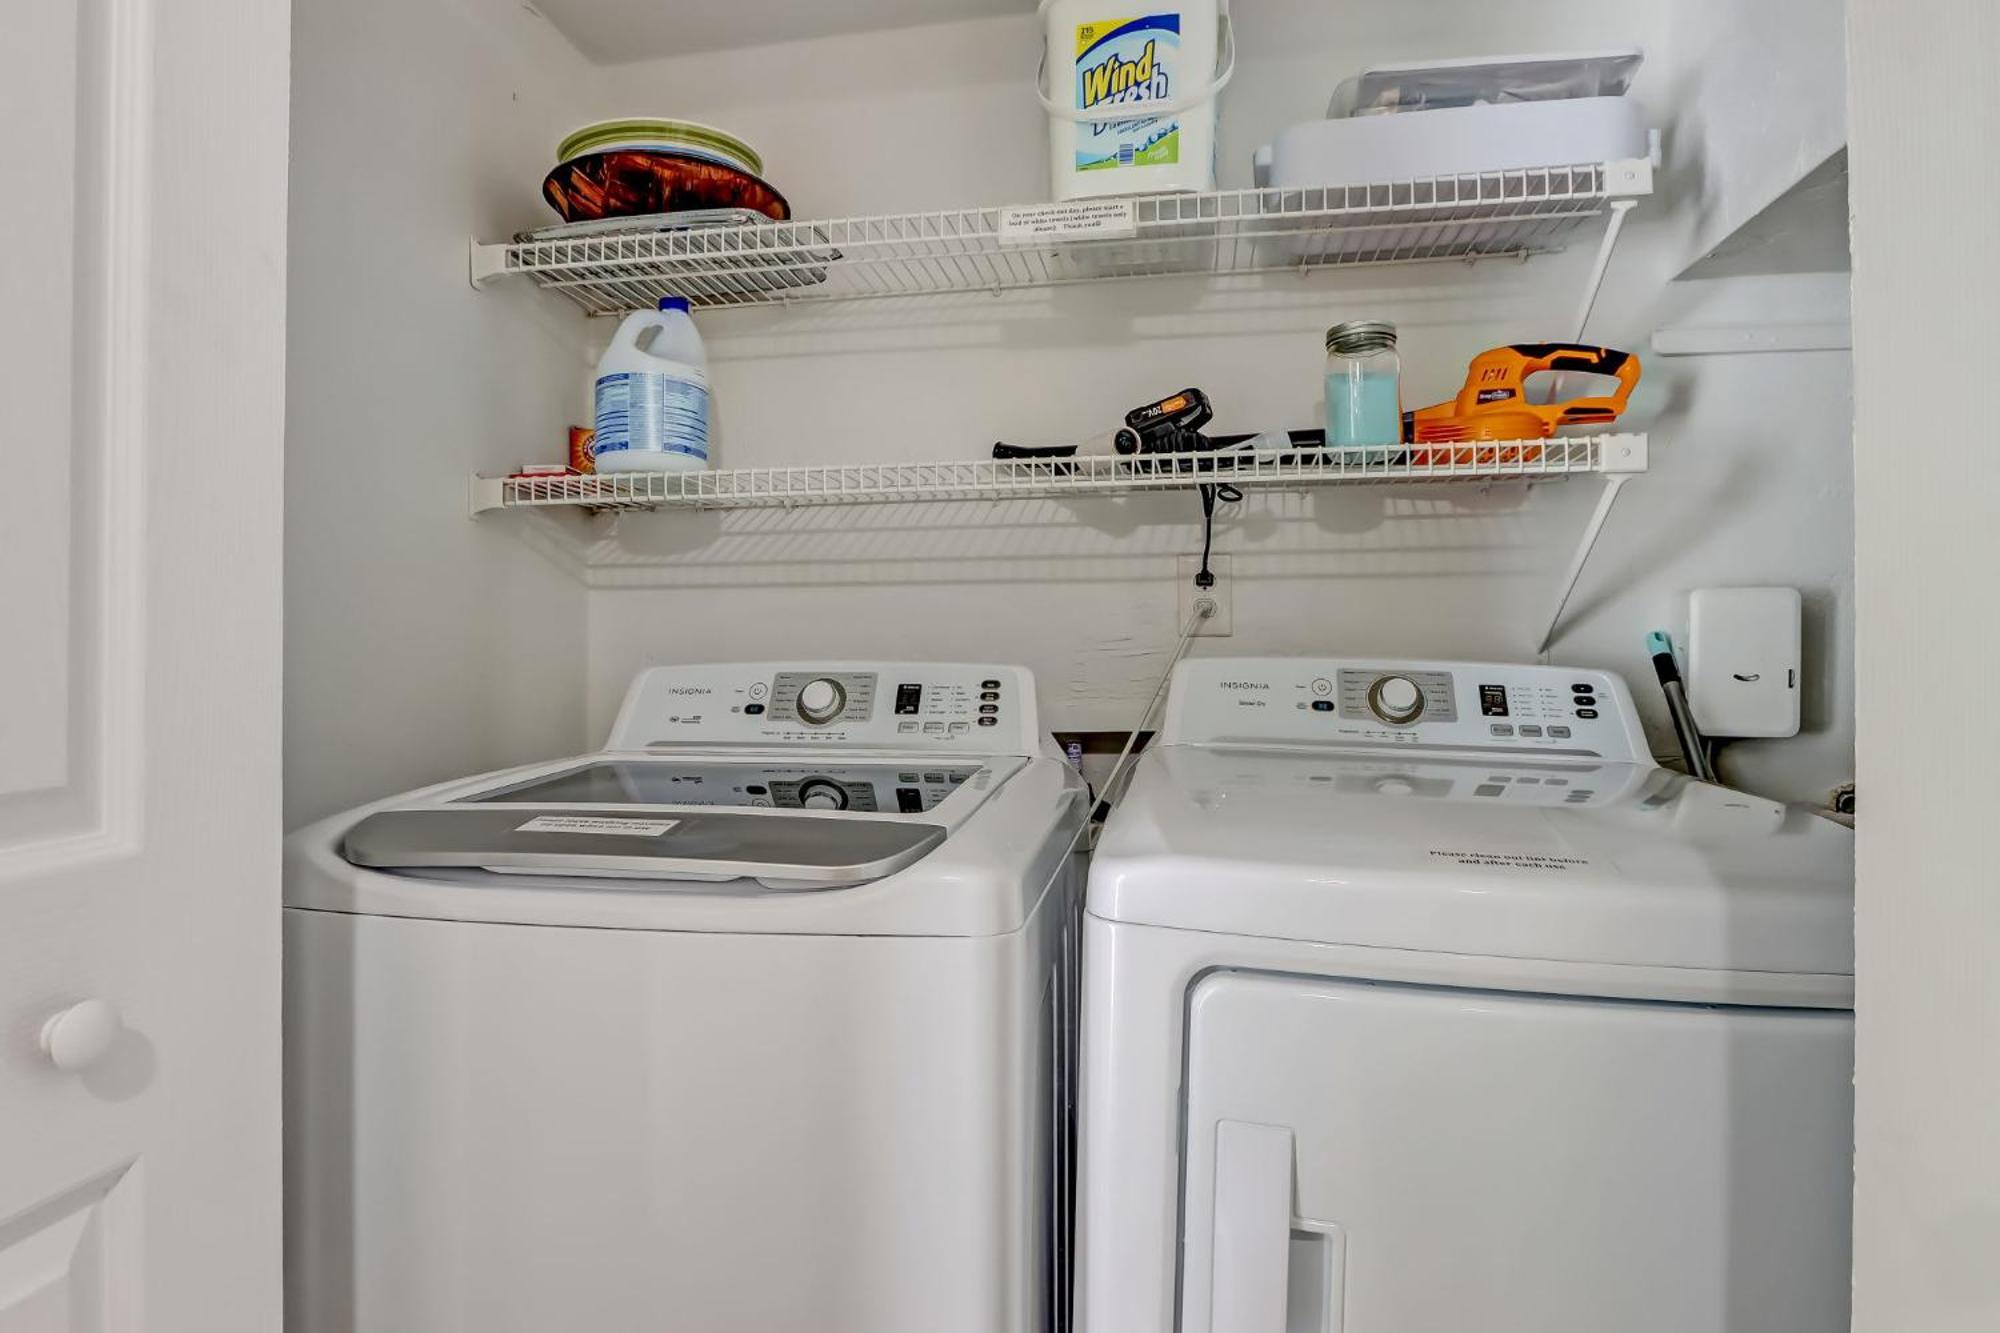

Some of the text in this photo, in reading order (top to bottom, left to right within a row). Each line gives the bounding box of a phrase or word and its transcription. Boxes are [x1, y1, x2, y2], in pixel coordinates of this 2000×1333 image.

[1083, 38, 1155, 109] Wind
[1096, 62, 1169, 105] resh
[1082, 205, 1101, 213] please
[668, 687, 712, 696] INSIGNIA
[1219, 681, 1269, 690] INSIGNIA
[1429, 850, 1467, 858] Please
[1469, 851, 1501, 860] clean
[1548, 856, 1589, 865] before
